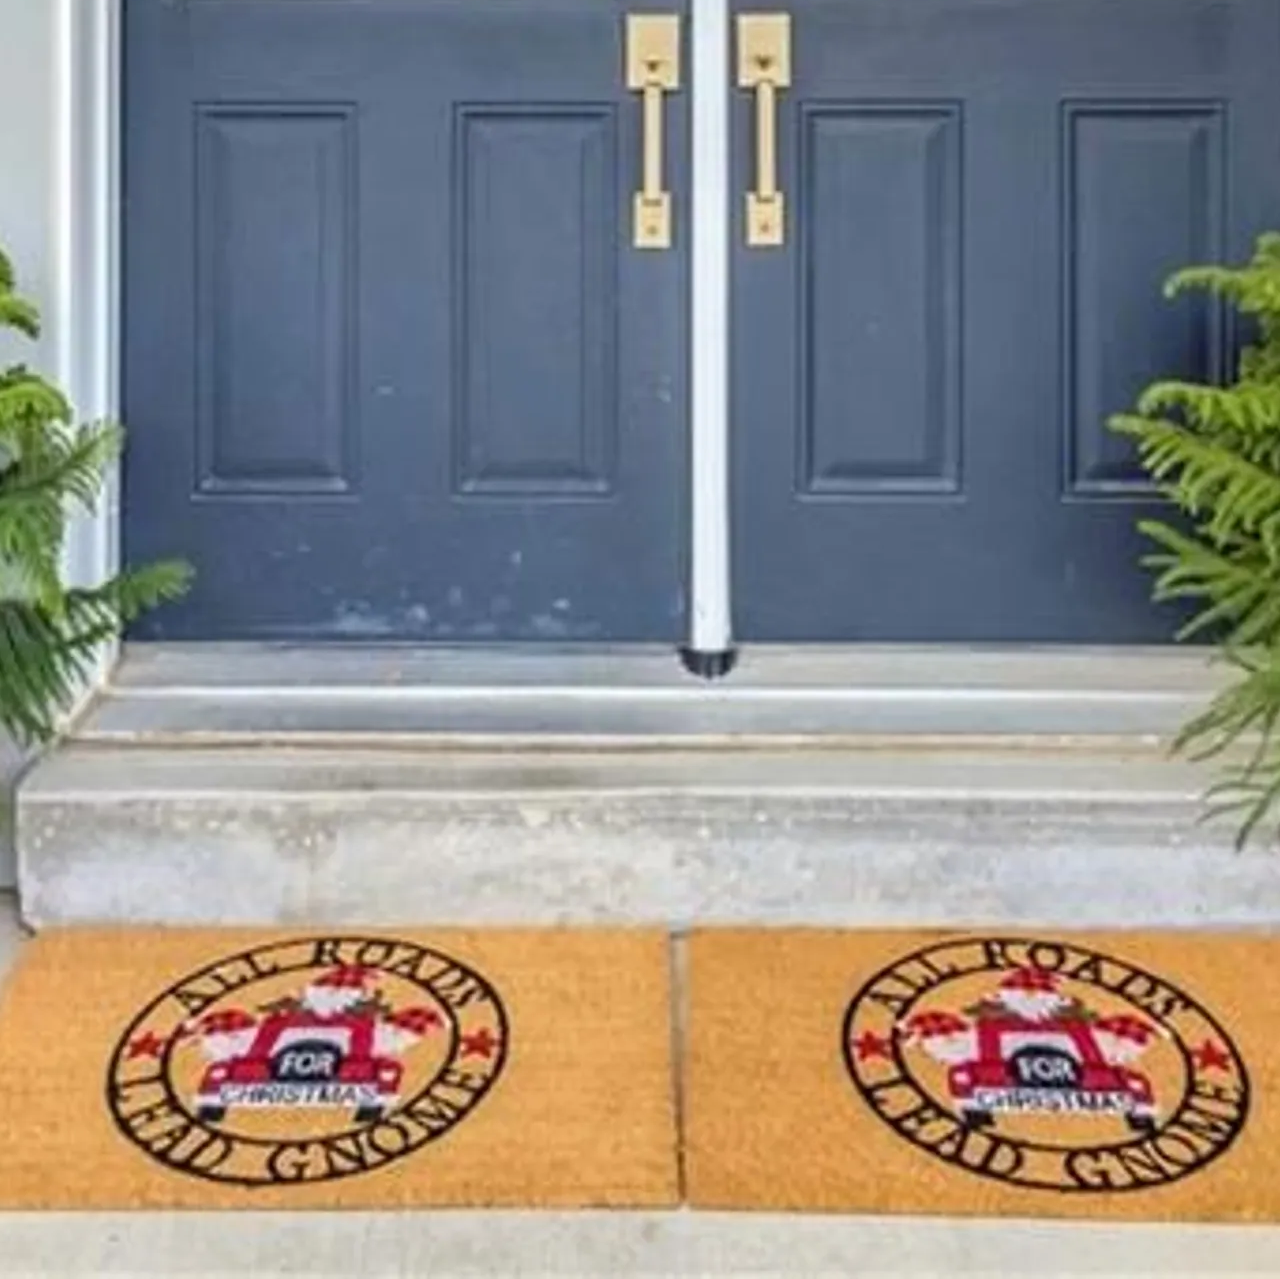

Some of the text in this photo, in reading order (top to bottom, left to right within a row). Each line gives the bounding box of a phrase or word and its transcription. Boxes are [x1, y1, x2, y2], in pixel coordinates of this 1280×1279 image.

[172, 939, 488, 1017] ALL ROADS
[869, 940, 1193, 1021] ALL ROADS
[277, 1049, 335, 1077] FOR
[1017, 1055, 1077, 1083] FOR
[220, 1082, 380, 1106] CHRISTMAS
[975, 1088, 1136, 1115] CHRISTMAS
[110, 1068, 486, 1182] LEAD GNOME
[866, 1079, 1245, 1188] LEAD GNOME
